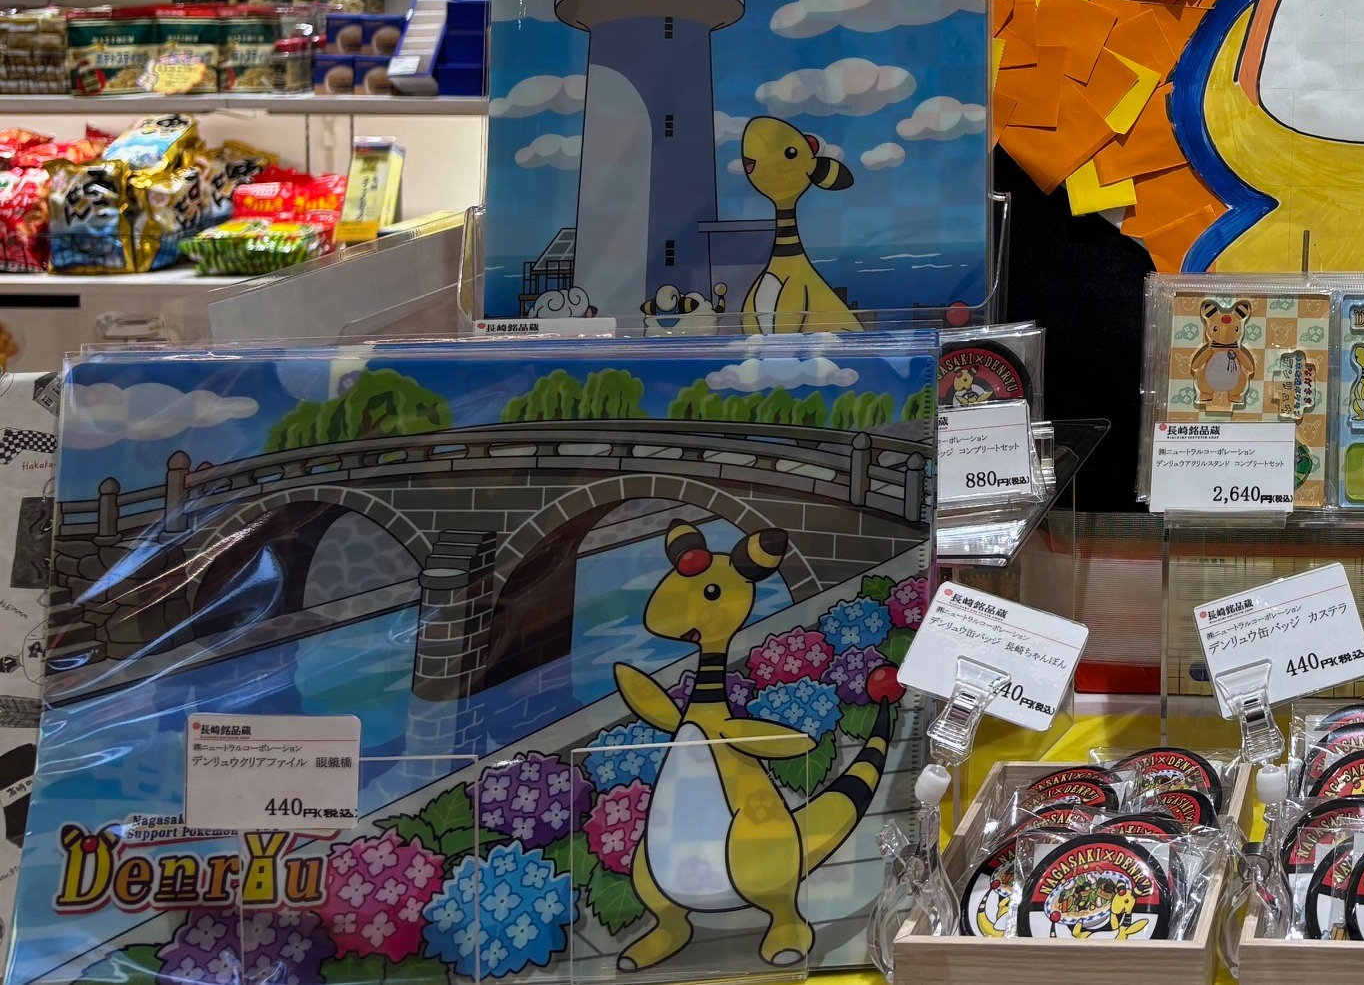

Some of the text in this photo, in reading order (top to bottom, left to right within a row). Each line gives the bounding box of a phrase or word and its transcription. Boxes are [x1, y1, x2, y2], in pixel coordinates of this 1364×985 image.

[1166, 425, 1221, 436] 長崎銘品蔵
[1208, 597, 1254, 621] 長崎銘品蔵
[1308, 602, 1348, 625] カステラ
[200, 724, 252, 736] 長崎銘品蔵
